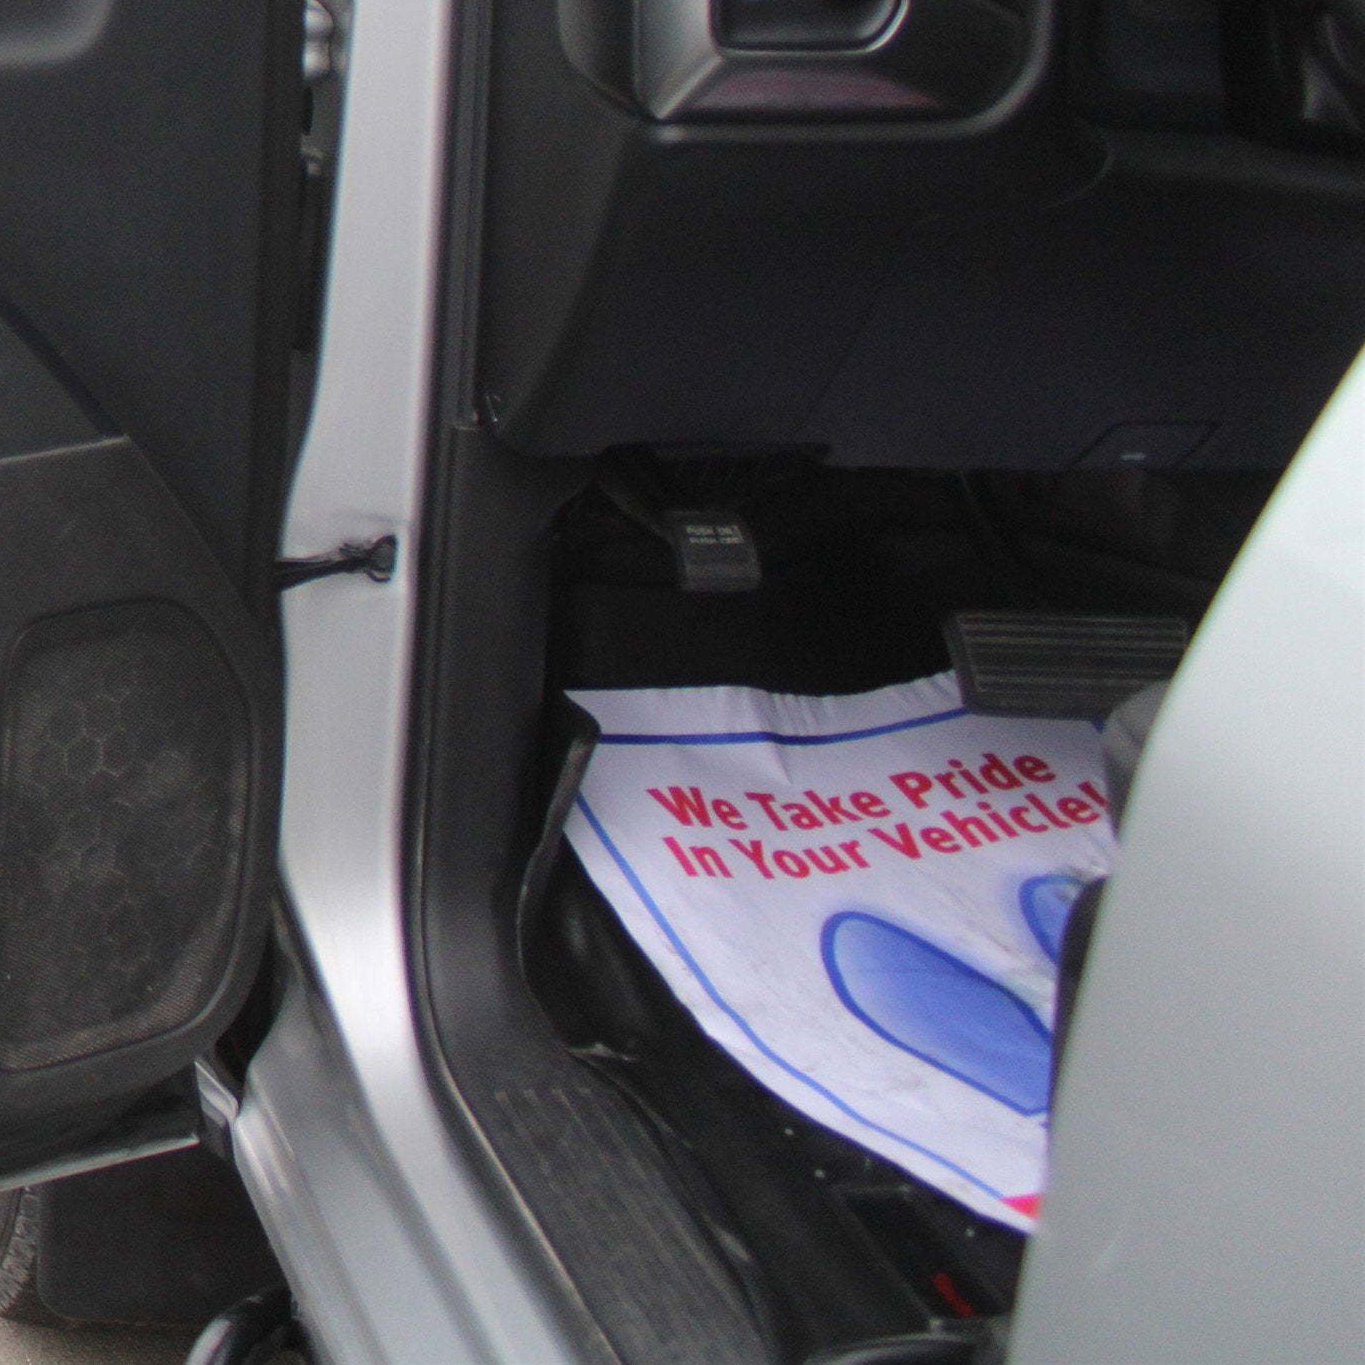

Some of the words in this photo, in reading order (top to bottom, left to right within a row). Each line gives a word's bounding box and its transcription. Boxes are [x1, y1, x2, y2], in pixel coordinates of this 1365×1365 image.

[646, 785, 747, 831] We
[746, 789, 891, 832] Take
[889, 752, 1056, 809] Pride
[665, 836, 732, 879] In
[731, 839, 868, 879] Your
